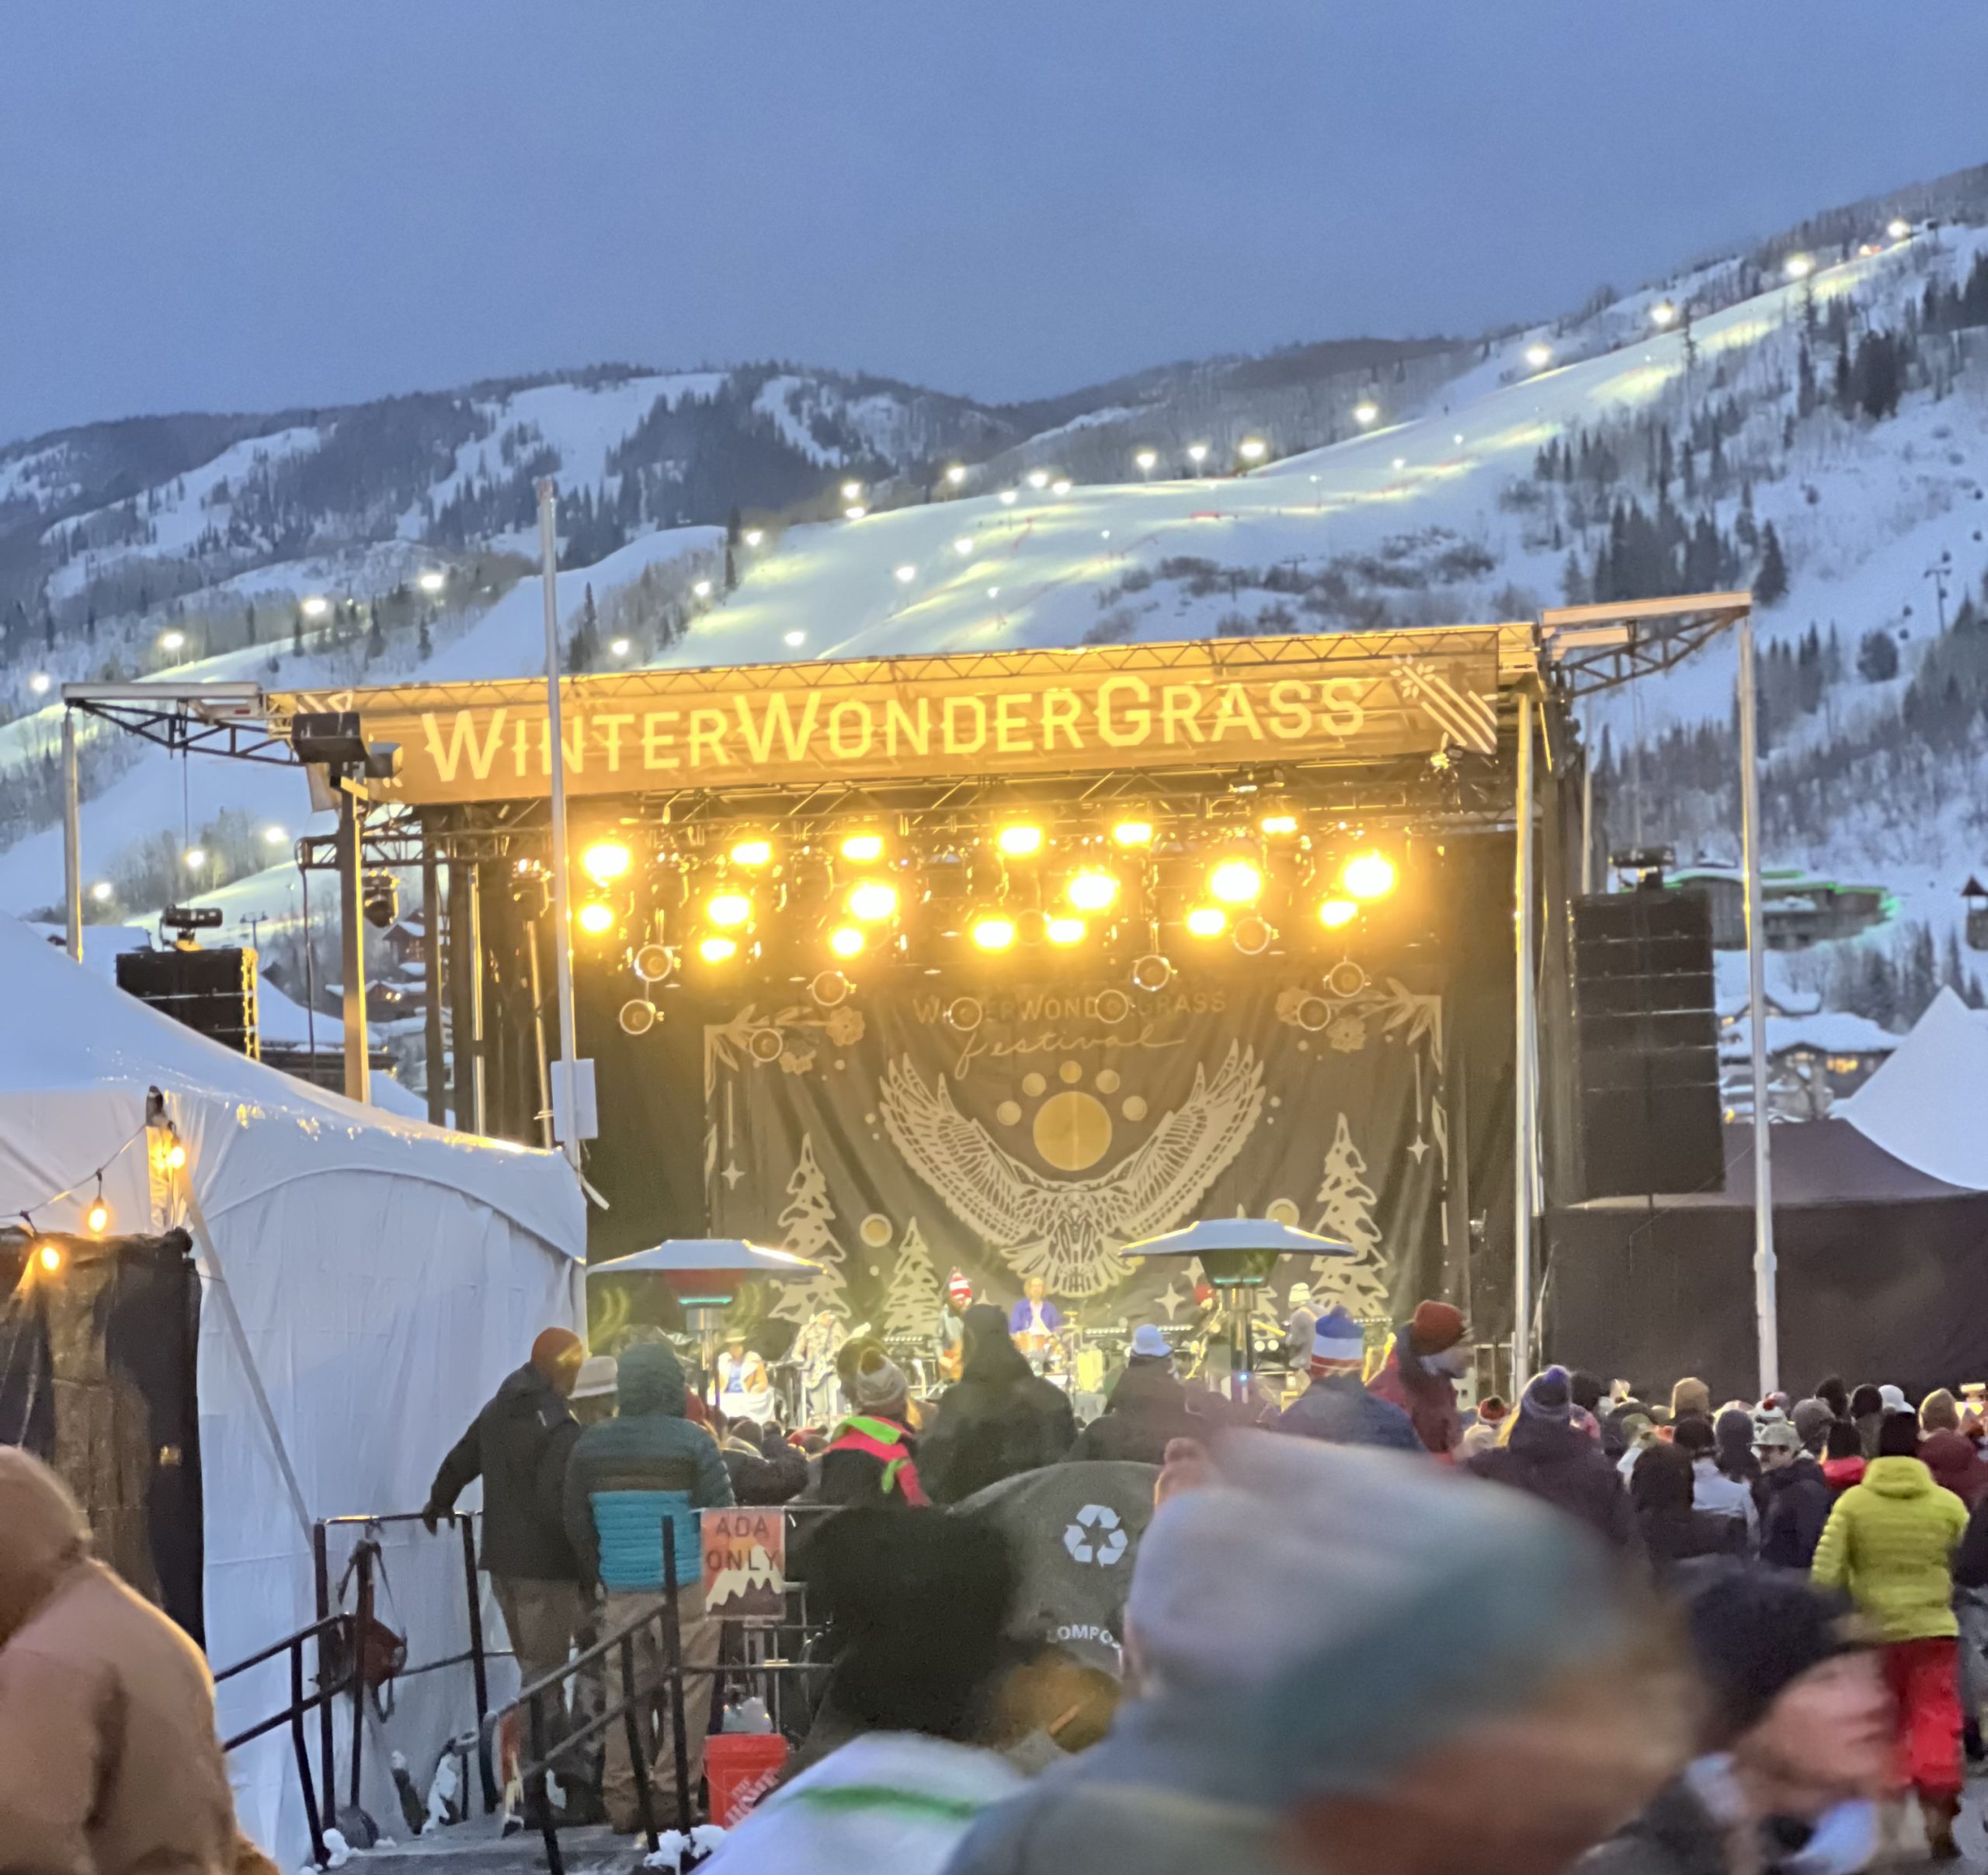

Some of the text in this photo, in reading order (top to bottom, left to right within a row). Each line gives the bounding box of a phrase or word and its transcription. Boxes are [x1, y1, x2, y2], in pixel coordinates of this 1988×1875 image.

[954, 1024, 1185, 1080] festival
[715, 1516, 770, 1538] ADA
[706, 1549, 779, 1571] ONLY
